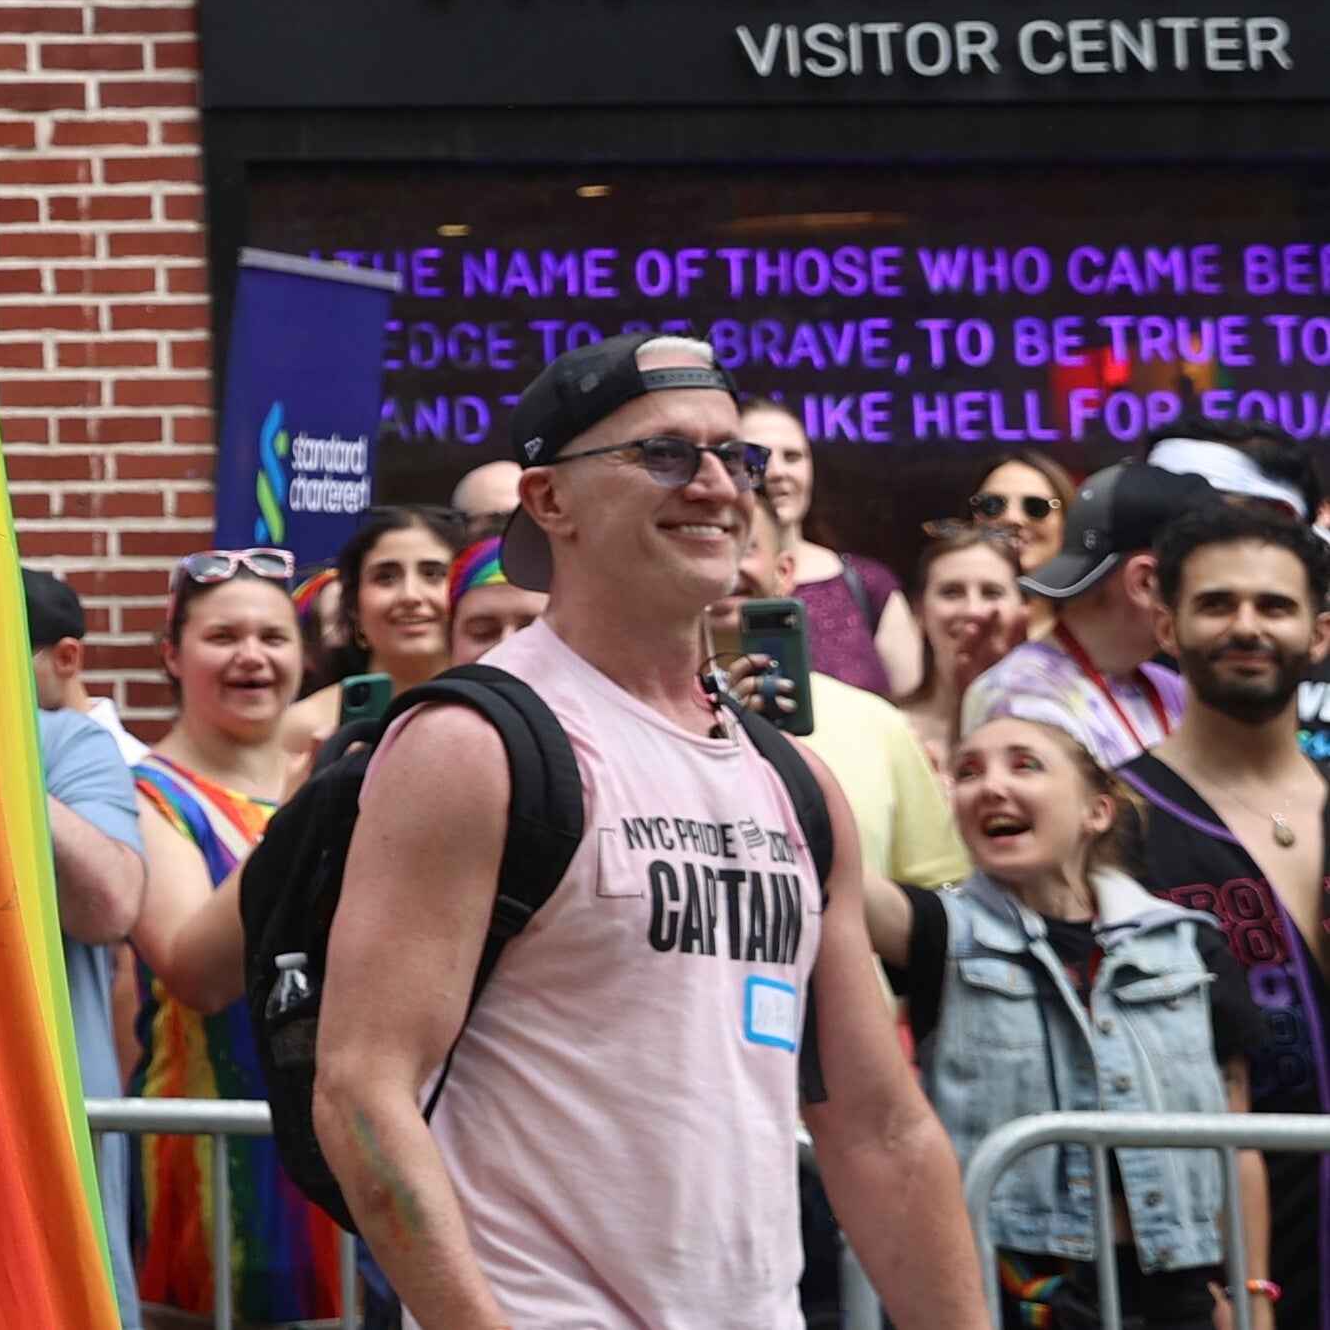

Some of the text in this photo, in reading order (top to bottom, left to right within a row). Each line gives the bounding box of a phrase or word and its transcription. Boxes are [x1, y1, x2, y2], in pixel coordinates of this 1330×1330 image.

[735, 17, 1294, 78] VISITOR CENTER
[461, 247, 619, 298] NAME
[634, 247, 708, 297] OF
[715, 245, 906, 298] THOSE
[917, 244, 1052, 296] WHO
[1067, 243, 1223, 296] CAME
[915, 318, 995, 368] TO
[1013, 315, 1089, 367] BE
[1096, 315, 1256, 366] TRUE
[1262, 314, 1330, 366] TO
[912, 389, 1060, 442] HELL
[291, 430, 368, 475] standard
[289, 471, 372, 515] chartered
[620, 816, 674, 851] NYC
[672, 817, 738, 859] PRIDE
[647, 858, 803, 965] CAPTAIN
